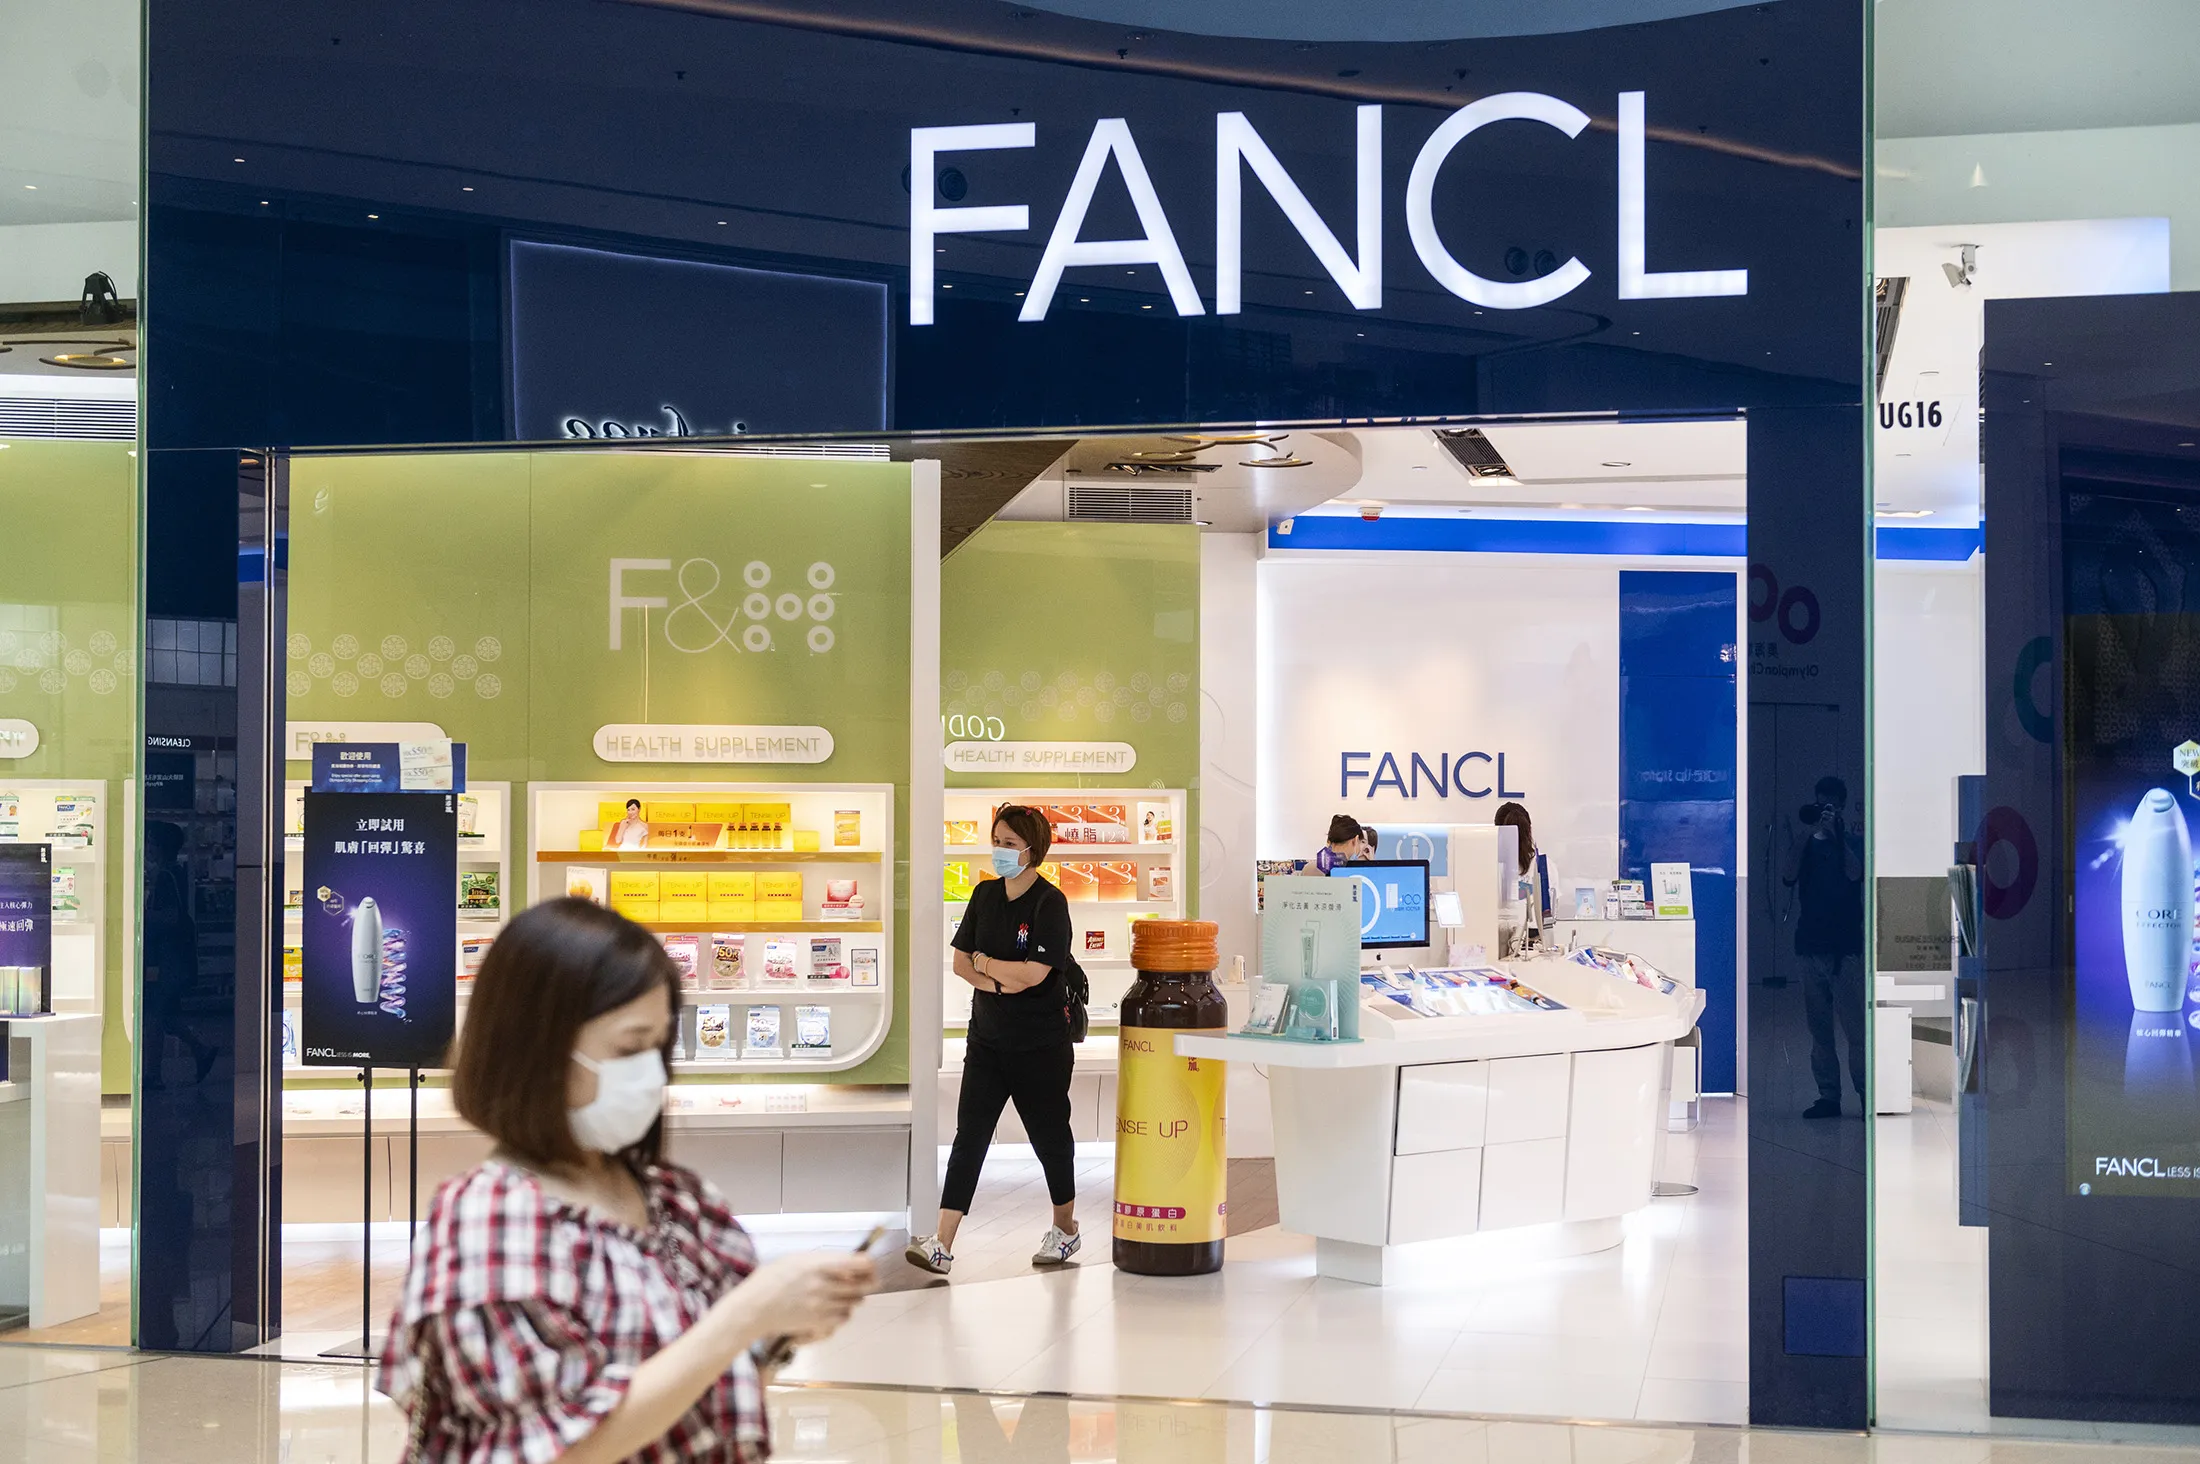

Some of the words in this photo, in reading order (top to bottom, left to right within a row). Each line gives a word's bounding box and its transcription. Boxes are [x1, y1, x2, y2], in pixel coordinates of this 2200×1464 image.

[910, 91, 1748, 326] FANCL
[1880, 401, 1942, 429] UG16
[606, 735, 682, 753] HEALTH
[694, 736, 821, 754] SUPPLEMENT
[954, 750, 1015, 763] HEALTH
[1023, 751, 1127, 764] SUPPLEMENT
[1341, 751, 1525, 799] FANCL
[356, 818, 405, 832] 立即試用
[335, 841, 426, 855] 肌膚「回彈」驚喜
[958, 863, 965, 884] 1
[1082, 863, 1095, 885] 3
[1120, 863, 1133, 885] 3
[306, 1047, 337, 1058] FANCL
[1123, 1039, 1155, 1052] FANCL
[1159, 1119, 1188, 1139] UP
[2096, 1157, 2166, 1178] FANCL
[2166, 1167, 2191, 1178] LESS
